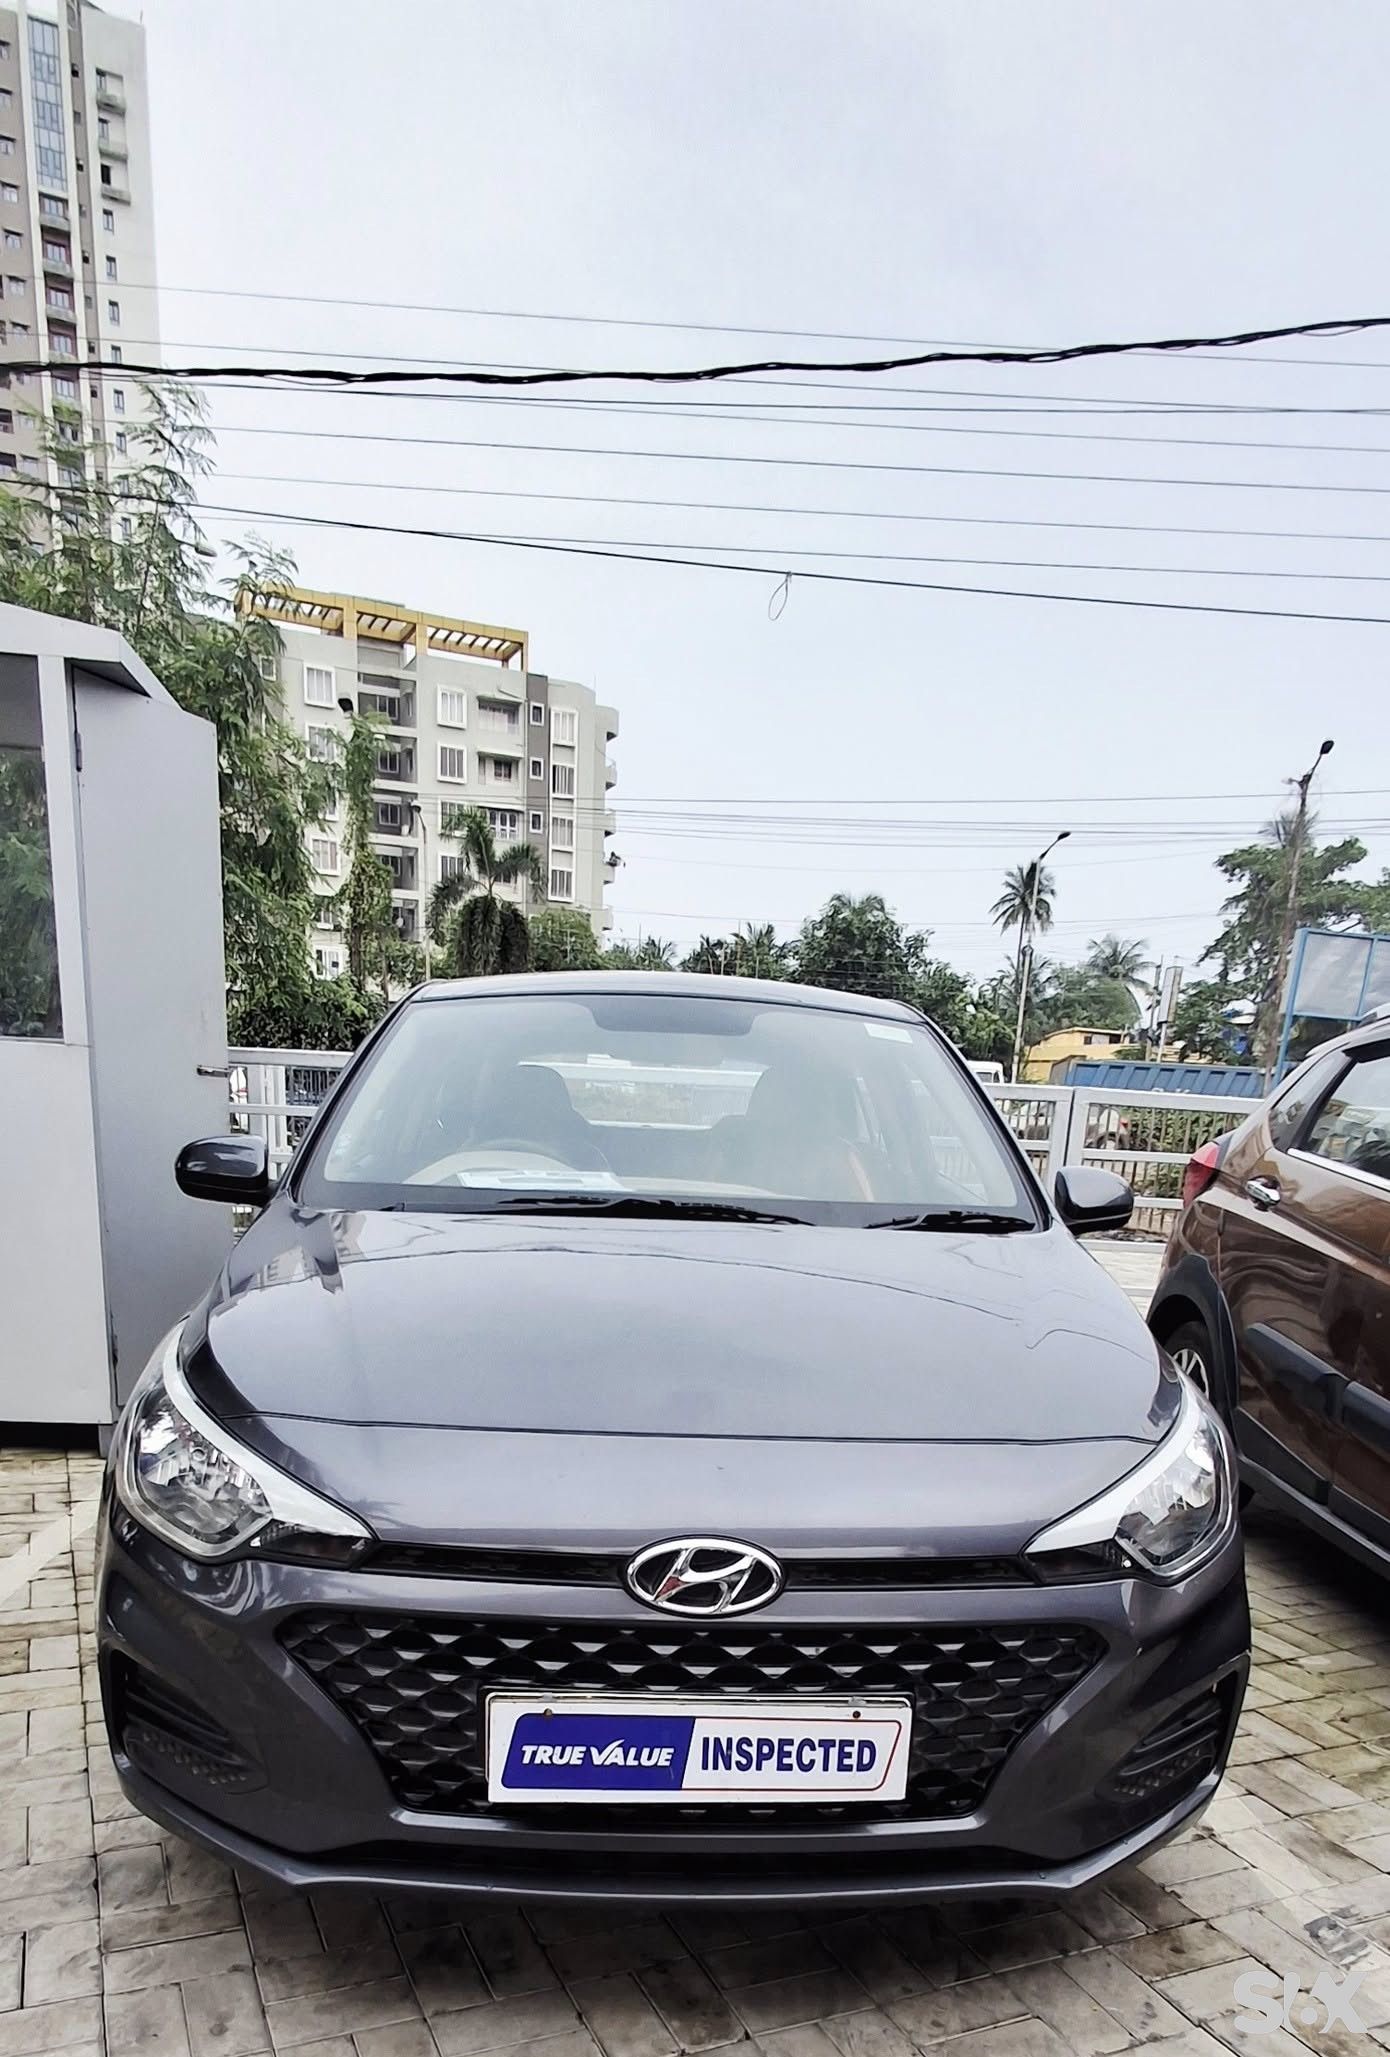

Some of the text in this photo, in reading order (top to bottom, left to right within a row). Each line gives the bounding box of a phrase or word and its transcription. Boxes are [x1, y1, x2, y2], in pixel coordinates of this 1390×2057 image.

[520, 1736, 877, 1773] TRUE VALUE INSPECTED
